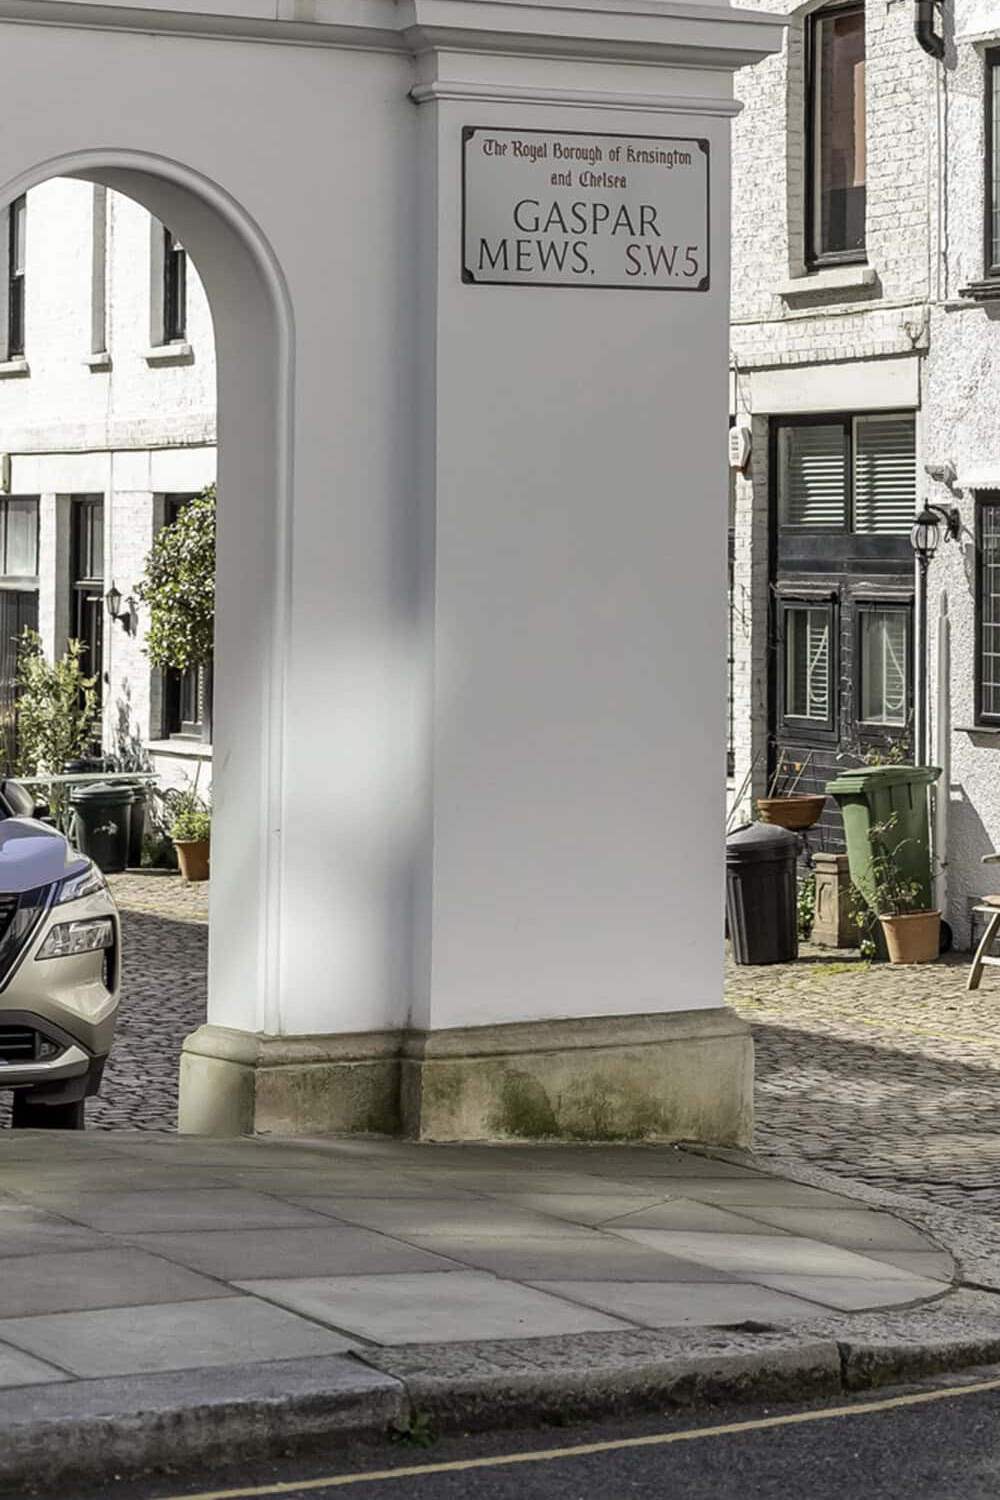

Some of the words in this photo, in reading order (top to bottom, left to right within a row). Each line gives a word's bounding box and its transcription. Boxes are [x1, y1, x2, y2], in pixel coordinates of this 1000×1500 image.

[483, 140, 508, 156] The
[512, 141, 547, 163] Royal
[553, 143, 602, 165] Borough
[609, 147, 620, 161] of
[627, 146, 691, 168] Kensington
[551, 171, 572, 186] and
[579, 171, 626, 188] Chelsea
[513, 200, 661, 236] GASPAR
[625, 244, 698, 276] S.W.5
